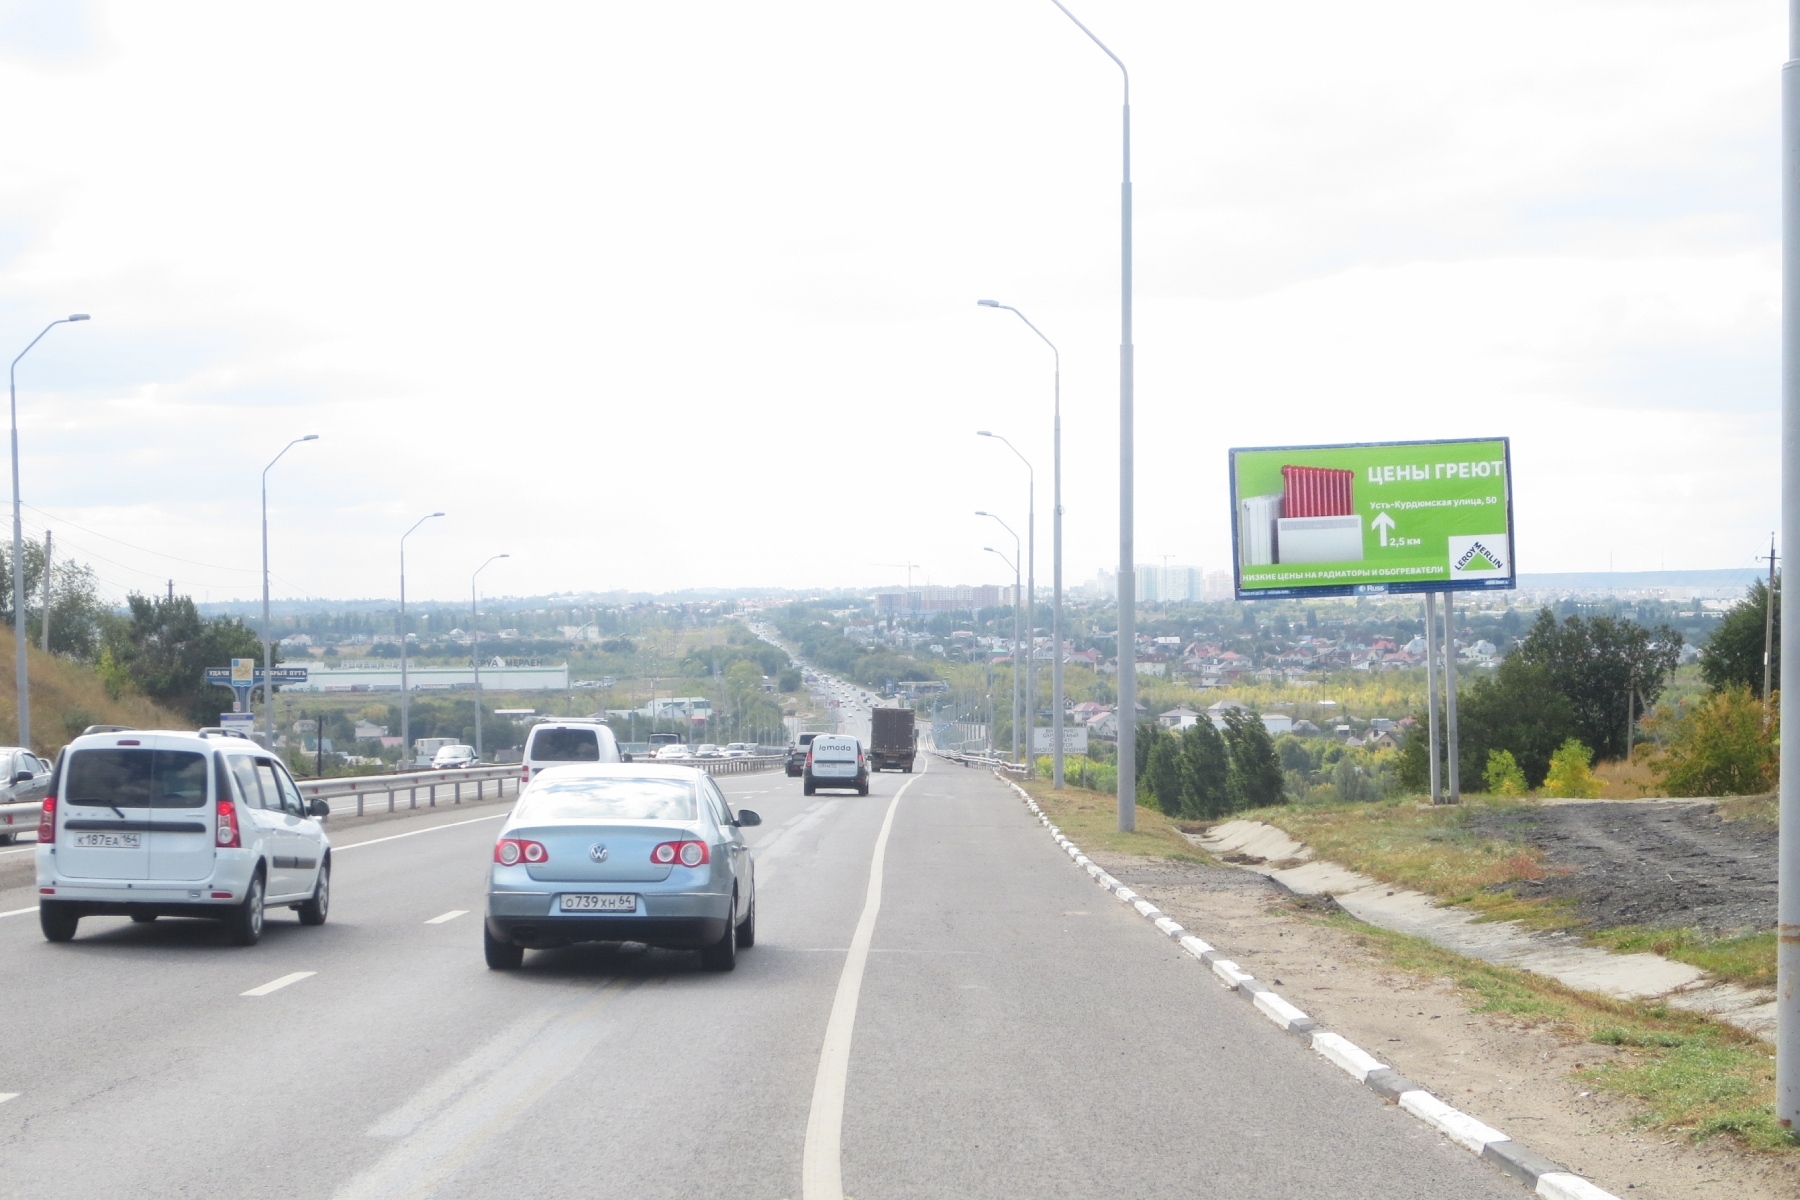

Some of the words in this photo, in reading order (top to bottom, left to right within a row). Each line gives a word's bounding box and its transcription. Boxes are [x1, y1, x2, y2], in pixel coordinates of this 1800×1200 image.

[1367, 464, 1430, 486] ЦЕНЫ
[1435, 460, 1503, 479] ГРЕЮТ
[1370, 500, 1452, 511] Усть-Курдюмская
[1453, 497, 1484, 508] улица,
[1485, 496, 1497, 505] 50
[1390, 537, 1405, 548] 2,5
[1406, 538, 1421, 546] км
[1454, 546, 1476, 571] LEROY
[1473, 541, 1503, 569] MERLIN
[1242, 573, 1276, 582] НИЗКИЕ
[1277, 572, 1304, 581] ЦЕНЫ
[1305, 571, 1317, 579] НА
[1318, 569, 1369, 579] РАДИАТОРЫ
[1371, 568, 1378, 576] И
[1378, 566, 1444, 576] ОБОГРЕВАТЕЛИ
